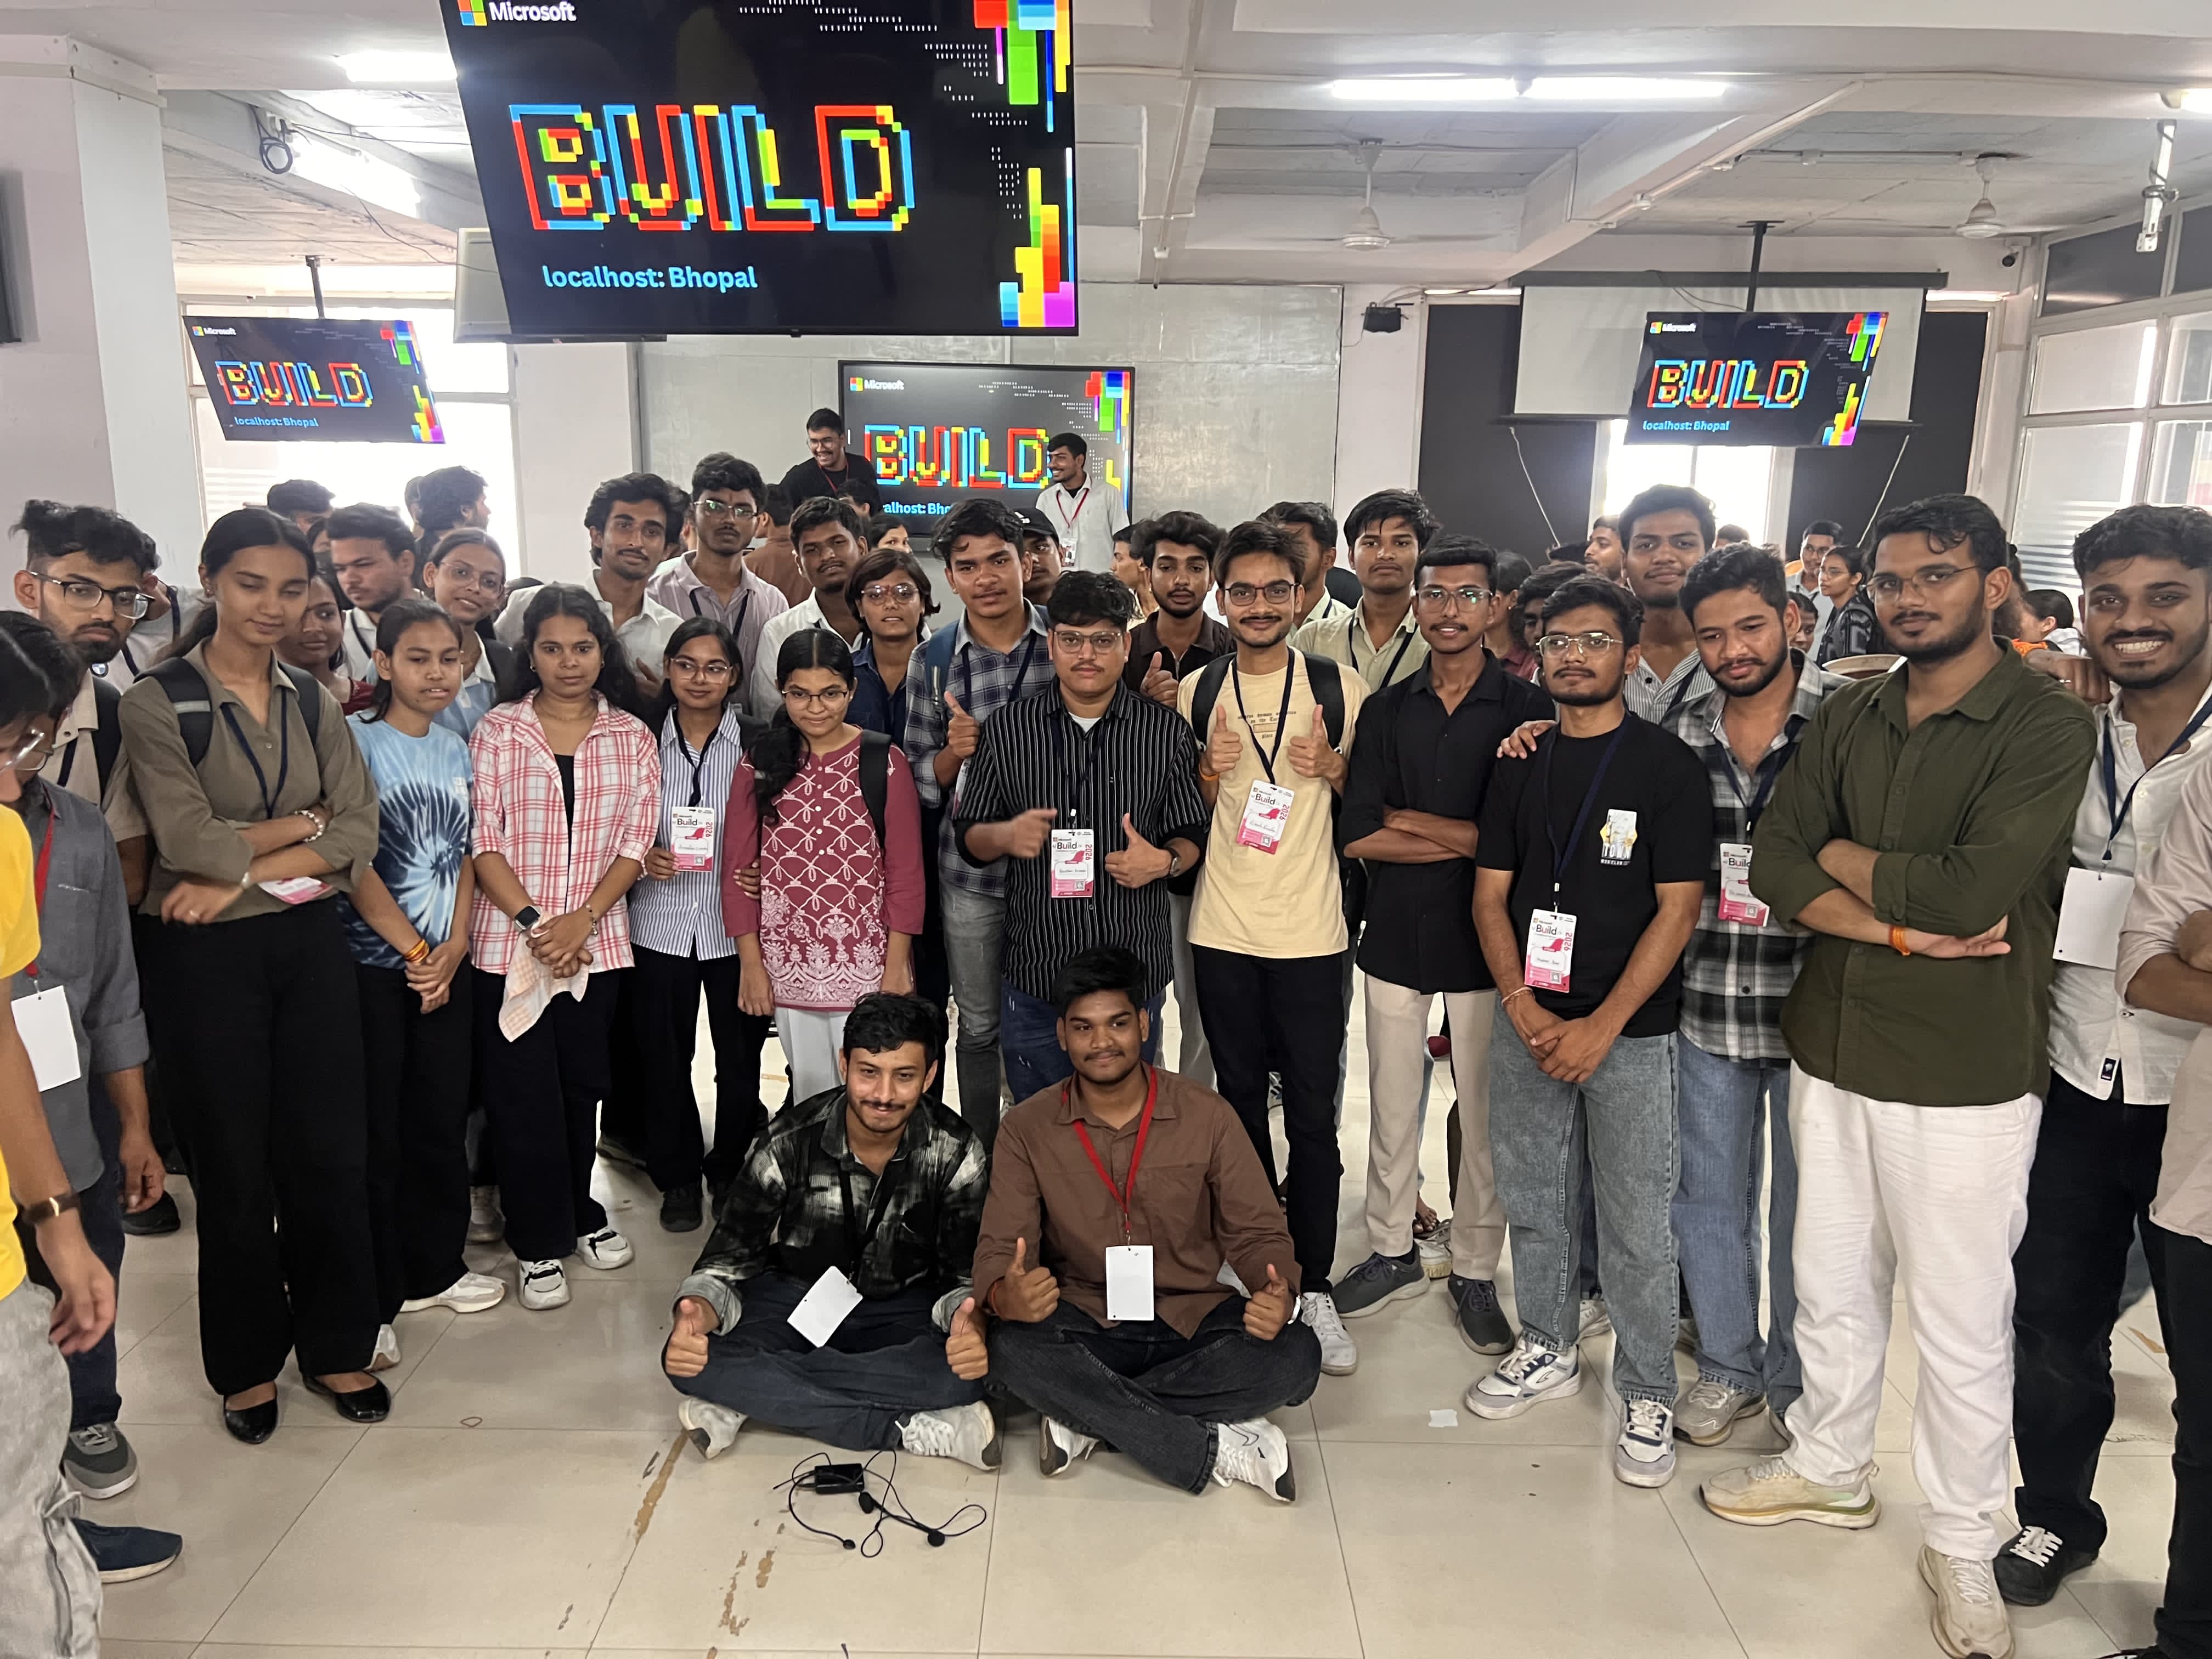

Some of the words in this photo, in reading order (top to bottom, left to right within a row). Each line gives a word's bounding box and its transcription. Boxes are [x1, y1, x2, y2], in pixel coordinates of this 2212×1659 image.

[488, 1, 577, 21] Microsoft
[509, 104, 915, 231] BUILD
[542, 266, 664, 289] localhost:
[669, 266, 758, 293] Bhopal
[203, 327, 237, 335] Microsoft
[215, 360, 374, 408] BUILD
[864, 379, 905, 390] Microsoft
[1647, 360, 1810, 408] BUILD
[234, 416, 283, 426] localhost:
[283, 417, 319, 428] Bhopal
[1643, 420, 1692, 430] localhost:
[1693, 421, 1730, 433] Bhopal
[864, 424, 1053, 489] BUILD
[883, 501, 926, 514] alhost:
[928, 503, 953, 515] Bho
[1255, 793, 1276, 805] Build
[1279, 804, 1290, 820] 2026
[1536, 924, 1557, 935] Build
[1564, 932, 1572, 951] 2026
